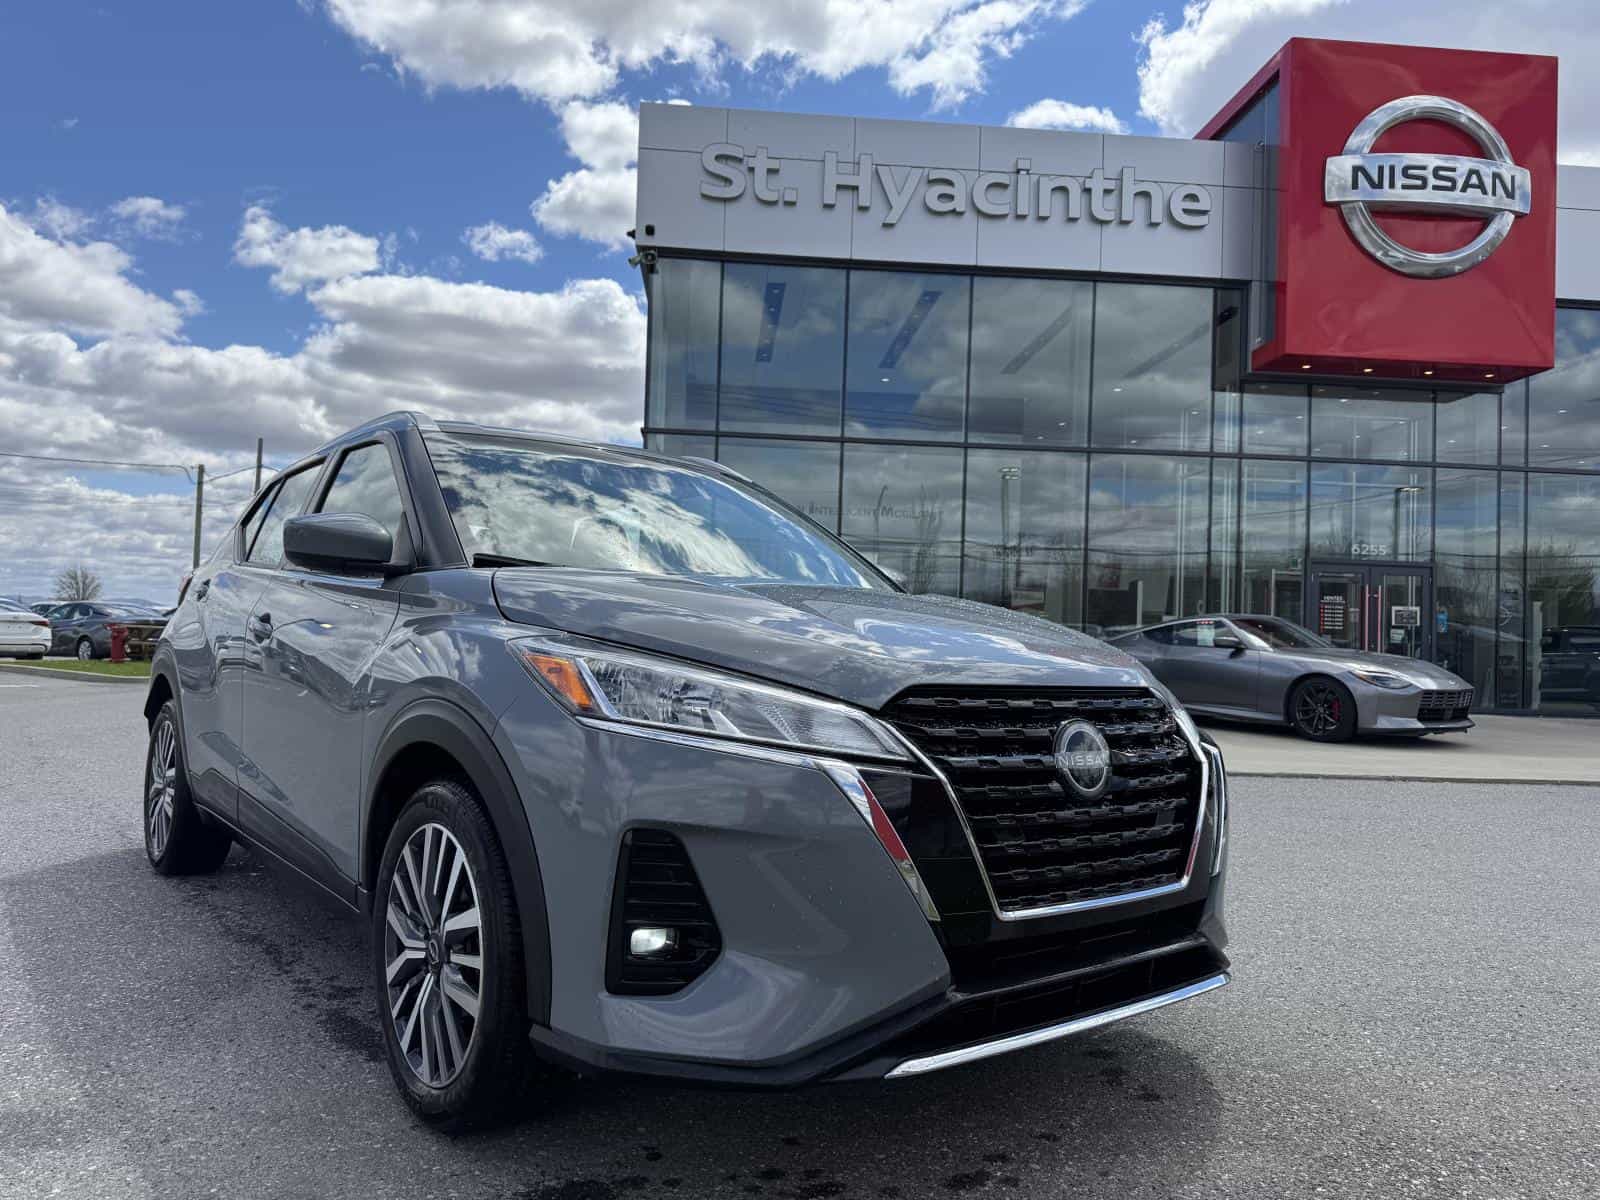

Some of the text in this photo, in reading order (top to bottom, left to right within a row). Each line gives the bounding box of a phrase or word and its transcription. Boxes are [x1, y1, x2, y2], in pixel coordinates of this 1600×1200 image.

[700, 142, 1212, 229] St. Hyacinthe
[1351, 164, 1517, 200] NISSAN
[1351, 543, 1387, 556] 6255
